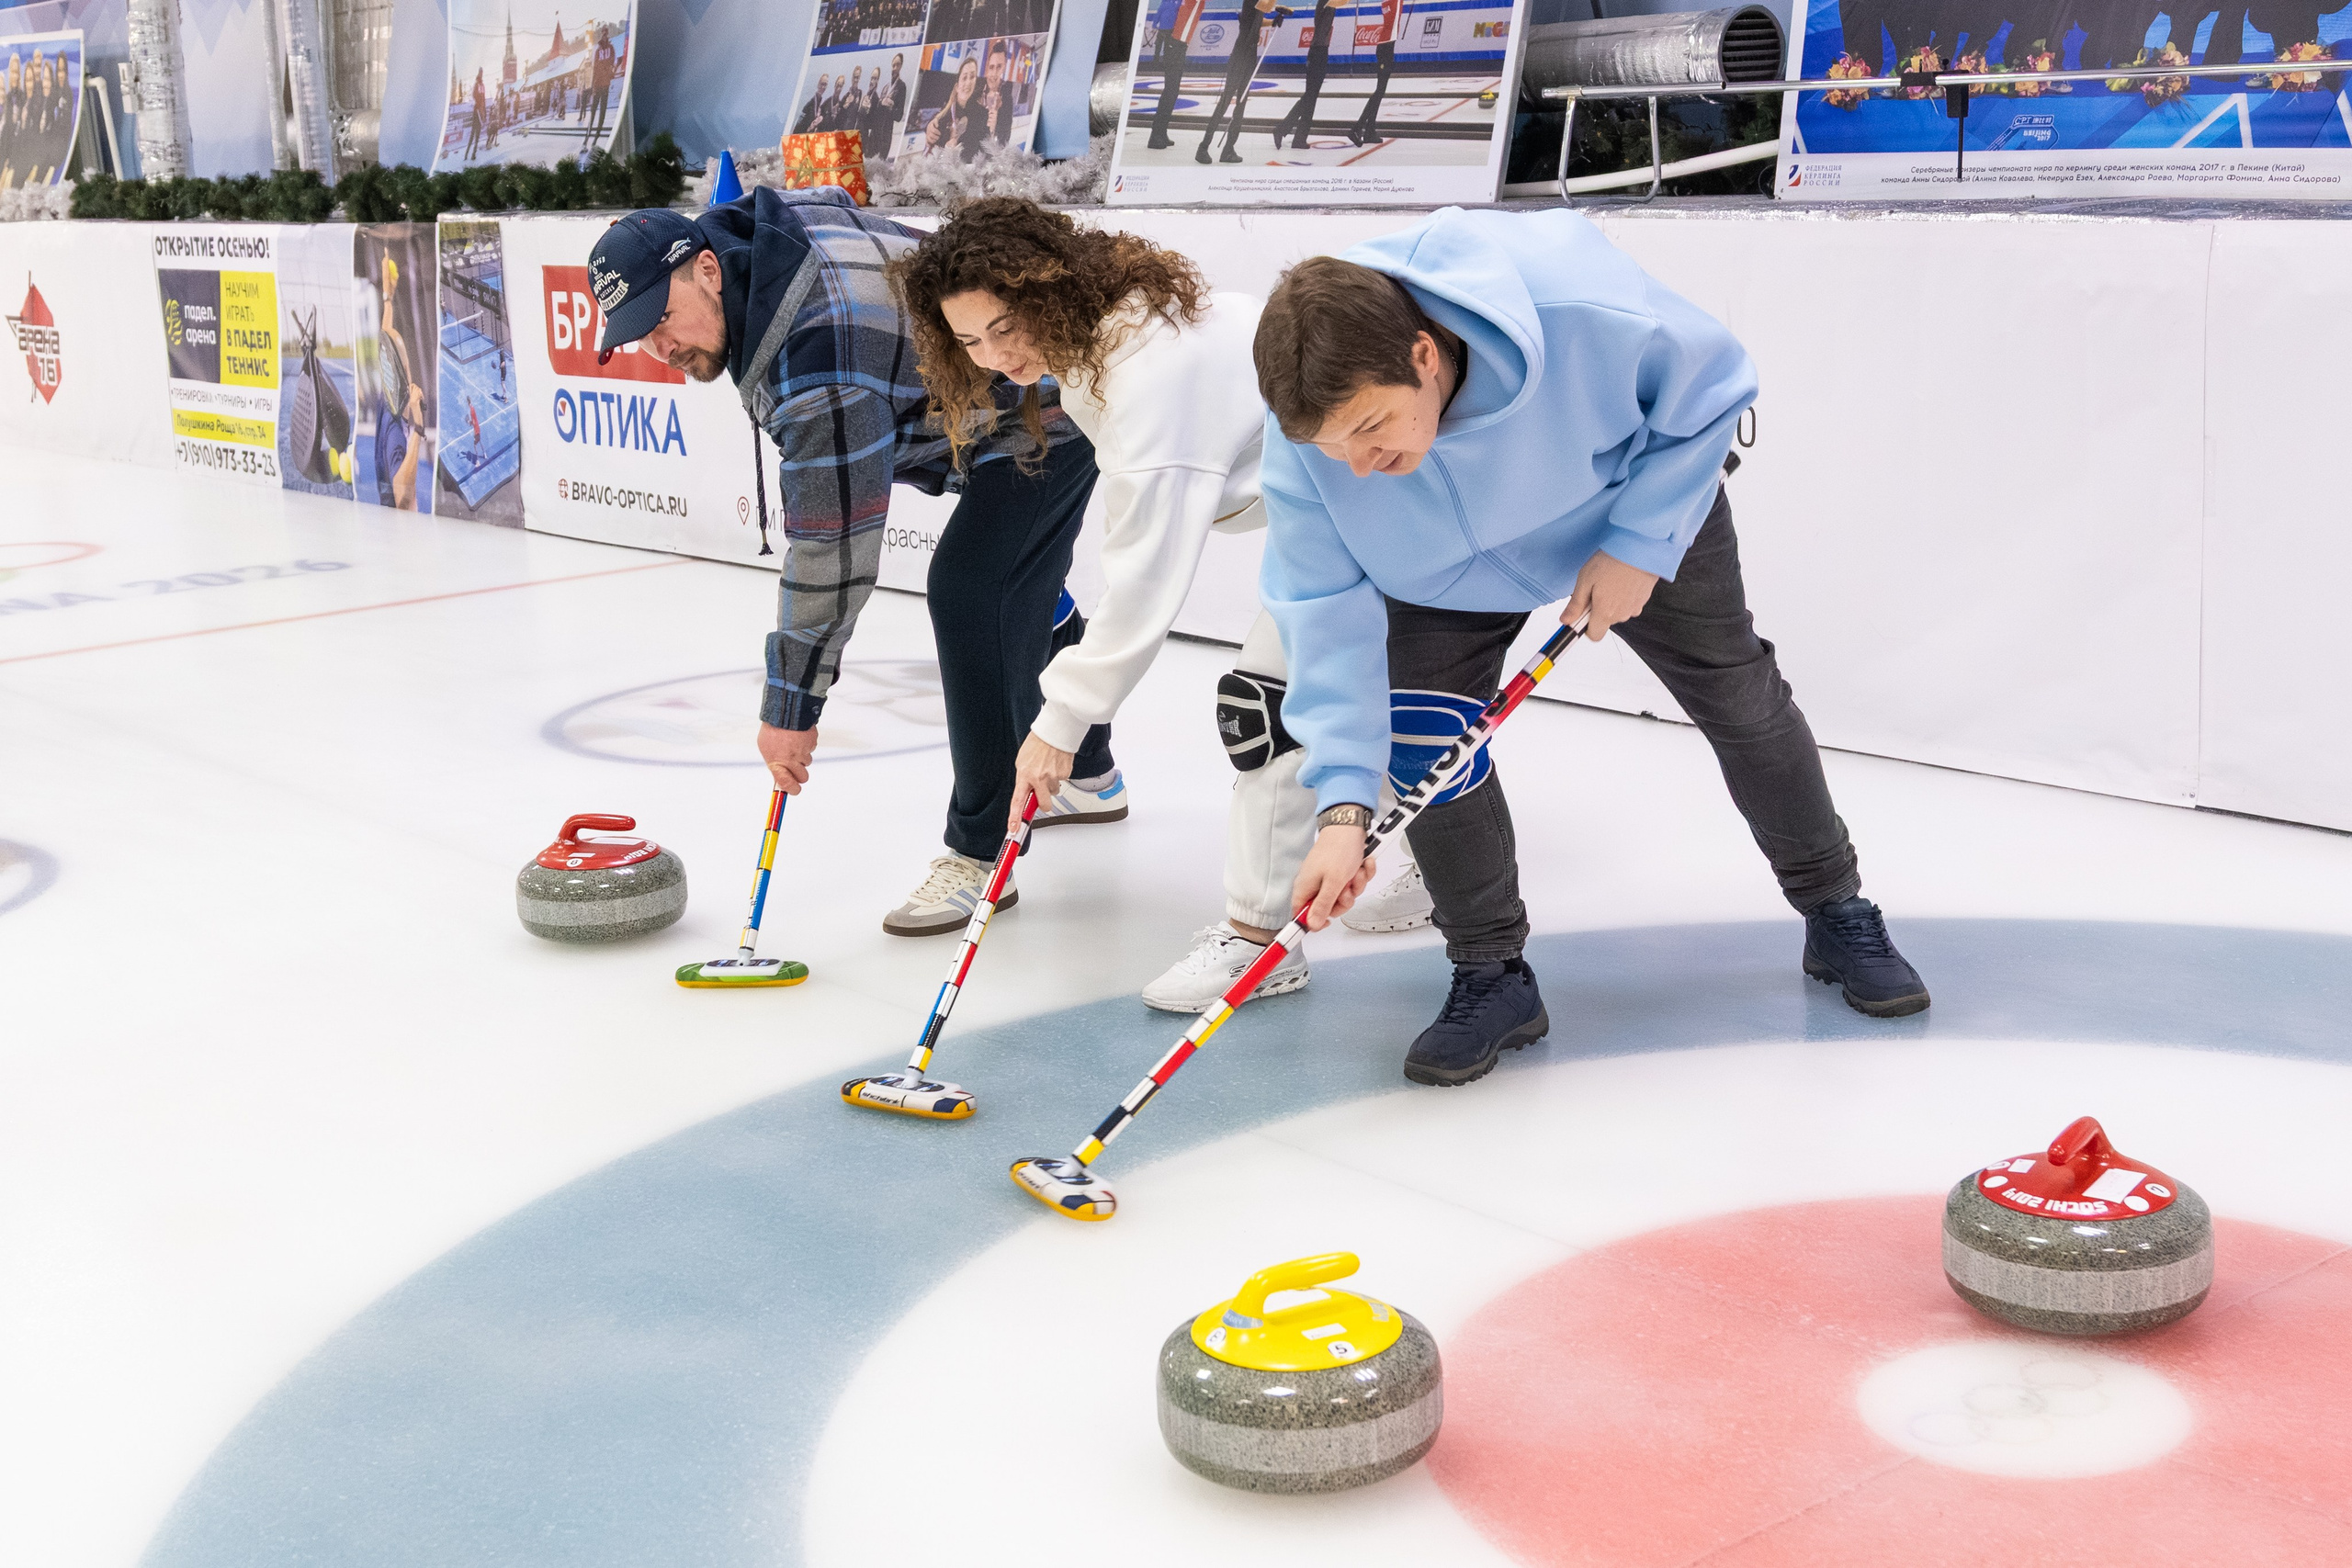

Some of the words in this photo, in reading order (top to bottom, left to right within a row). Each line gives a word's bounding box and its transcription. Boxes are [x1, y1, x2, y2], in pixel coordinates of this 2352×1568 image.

[1881, 175, 1910, 184] команда
[1931, 175, 1970, 184] Сидороой
[1972, 175, 1996, 183] (Алина
[1998, 175, 2035, 183] Ковалева,
[2037, 175, 2074, 183] Нкеирука
[2075, 174, 2095, 183] Езех,
[2097, 174, 2145, 182] Александра
[2147, 174, 2175, 182] Раева,
[2177, 174, 2223, 183] Маргарита
[2226, 174, 2265, 183] Фомина,
[2267, 175, 2290, 183] Анна
[2293, 175, 2341, 184] Сидорова)
[1910, 165, 1954, 175] Серебряные
[2065, 164, 2101, 173] керлингу
[2103, 164, 2127, 173] среди
[2129, 164, 2164, 172] женских
[2165, 164, 2197, 172] команд
[2199, 164, 2219, 172] 2017
[2237, 164, 2269, 172] Пекине
[2271, 164, 2305, 173] (Китай)
[155, 236, 215, 257] ОТКРЫТИЕ
[218, 236, 270, 259] ОСЕНЬЮ!
[667, 245, 691, 264] NARVAL
[225, 282, 260, 299] НАУЧИМ
[184, 305, 217, 323] падел.
[225, 305, 255, 323] ИГРАТЬ
[186, 328, 217, 347] арена
[226, 328, 232, 347] В
[233, 330, 272, 353] ПАДЕЛ
[226, 355, 270, 378] ТЕННИС
[217, 393, 247, 410] ТУРНИРЫ
[254, 398, 273, 412] ИГРЫ
[176, 413, 215, 432] Полушкина
[216, 419, 236, 436] Роща
[554, 388, 687, 457] ОПТИКА
[571, 481, 687, 518] BRAVO-OPTICA.RU
[119, 559, 353, 595] 2026
[2001, 1187, 2045, 1208] 2014
[2043, 1199, 2109, 1214] SOCHI
[1335, 1343, 1348, 1355] 5
